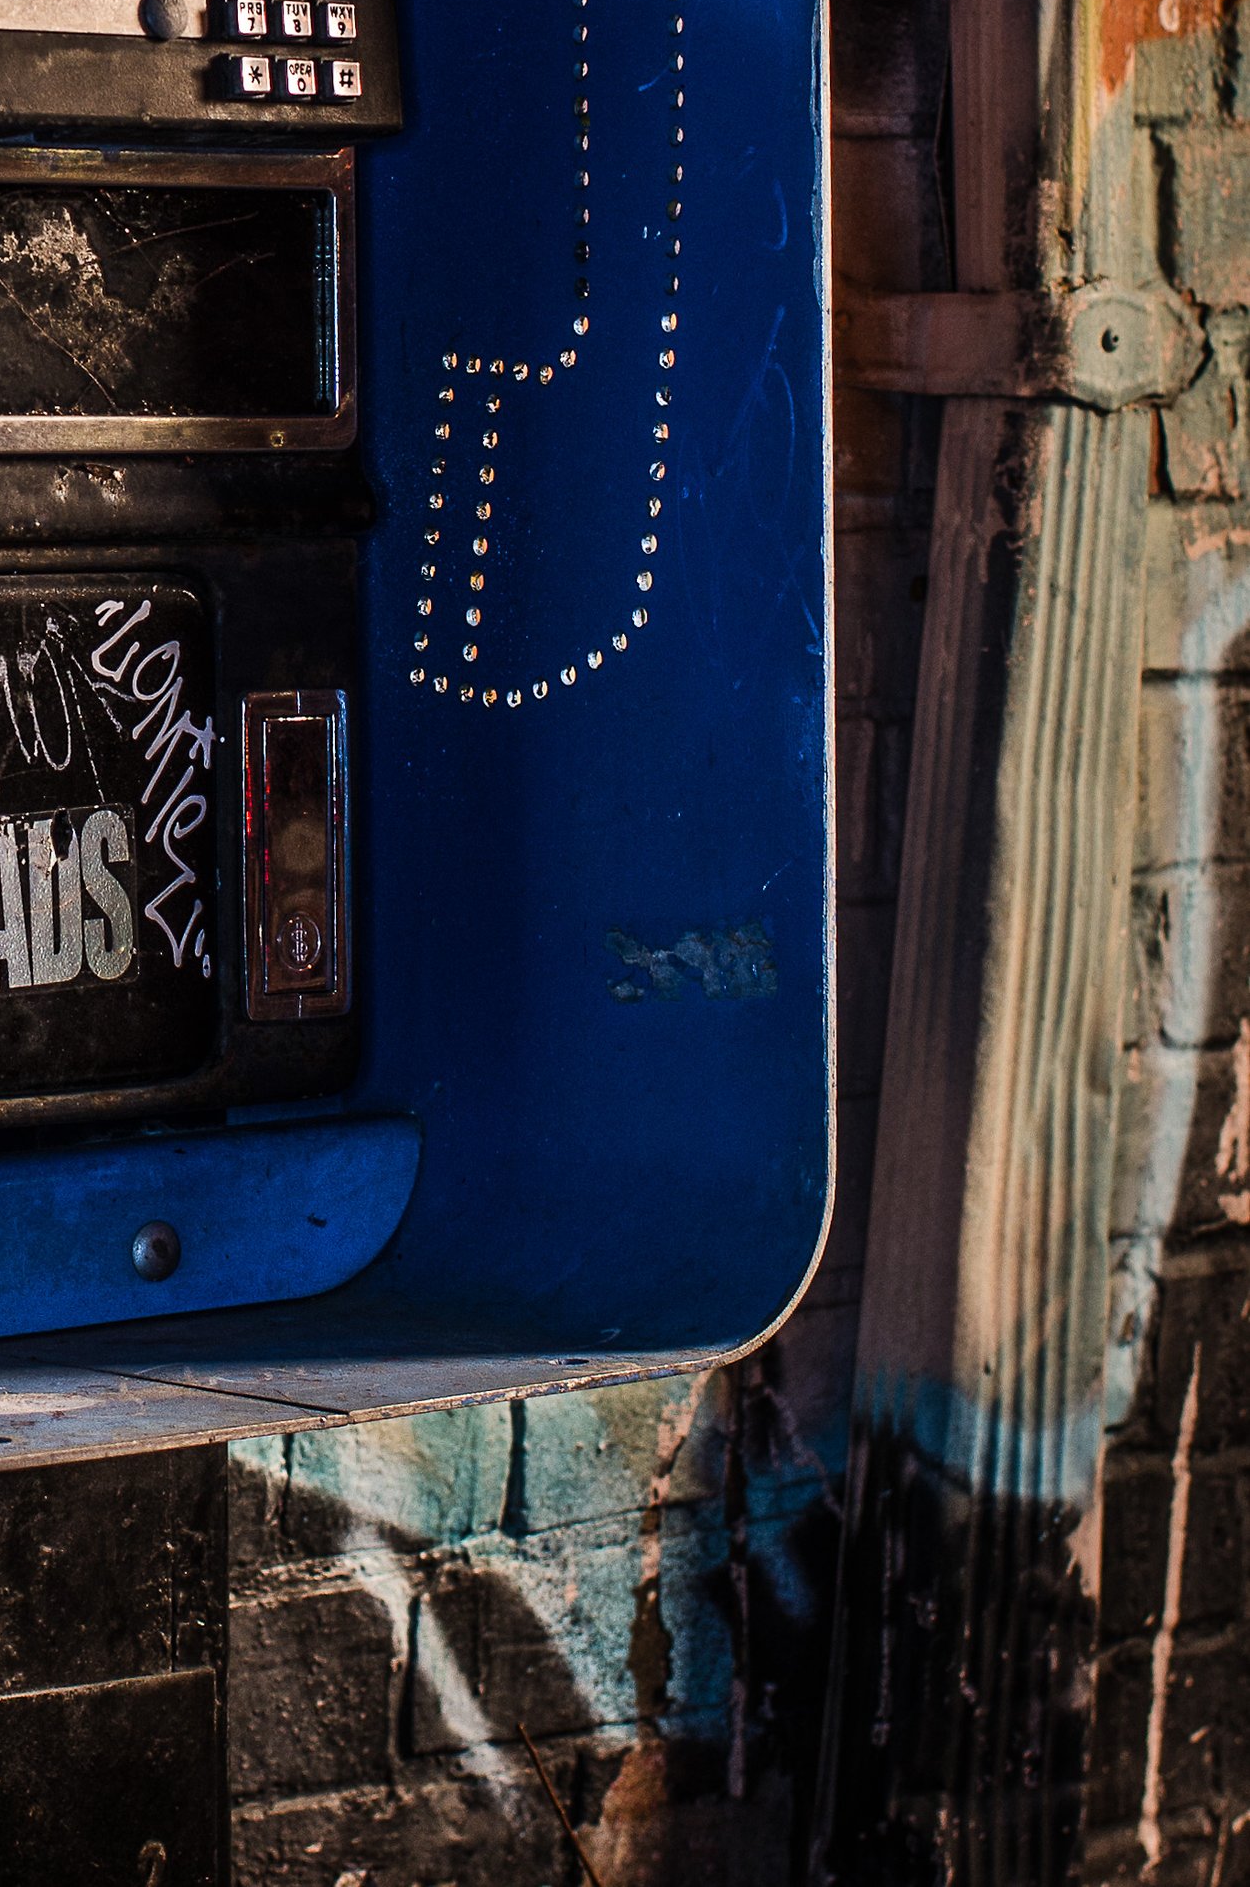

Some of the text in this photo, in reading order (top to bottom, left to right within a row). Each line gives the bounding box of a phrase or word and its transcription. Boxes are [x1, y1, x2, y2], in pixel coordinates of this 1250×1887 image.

[240, 2, 262, 15] PRS
[285, 3, 308, 17] TUV
[330, 6, 353, 19] WXY
[247, 18, 256, 31] 7
[293, 19, 302, 33] 8
[337, 21, 347, 35] 9
[288, 62, 312, 76] OPER
